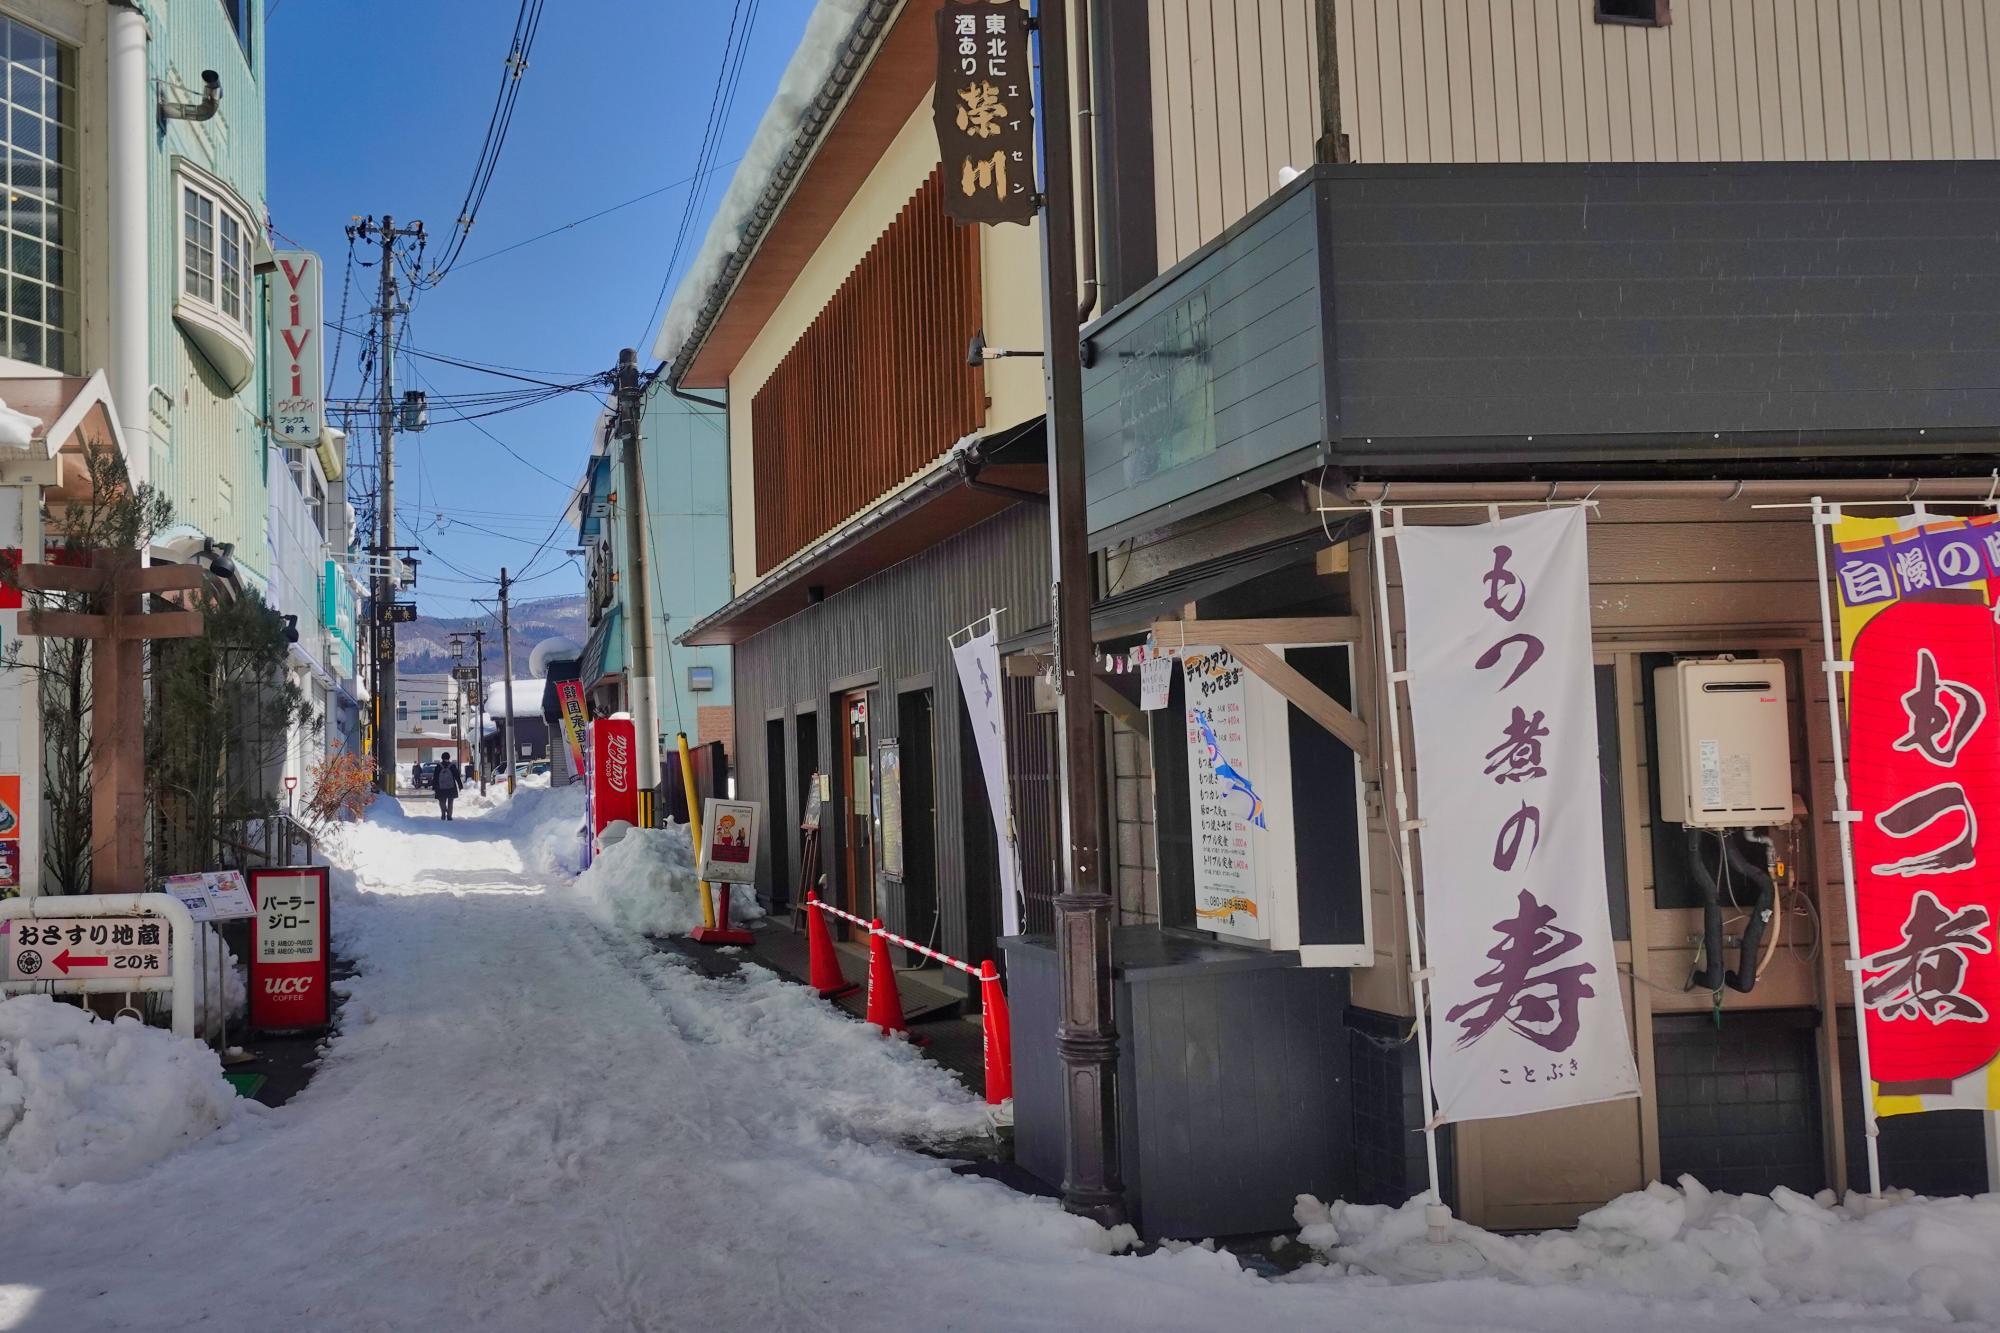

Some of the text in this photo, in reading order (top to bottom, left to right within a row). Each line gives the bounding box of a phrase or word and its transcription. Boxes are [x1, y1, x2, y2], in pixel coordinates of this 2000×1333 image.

[954, 14, 977, 76] 酒あり
[985, 13, 1007, 77] 東北に
[1008, 85, 1025, 194] エイセン
[1864, 648, 1992, 1026] もつ煮
[18, 924, 160, 945] おさすり地蔵
[268, 914, 310, 929] ジロー
[113, 954, 159, 970] この先
[272, 994, 304, 1002] COFFEE
[1499, 1058, 1578, 1084] ことぶき
